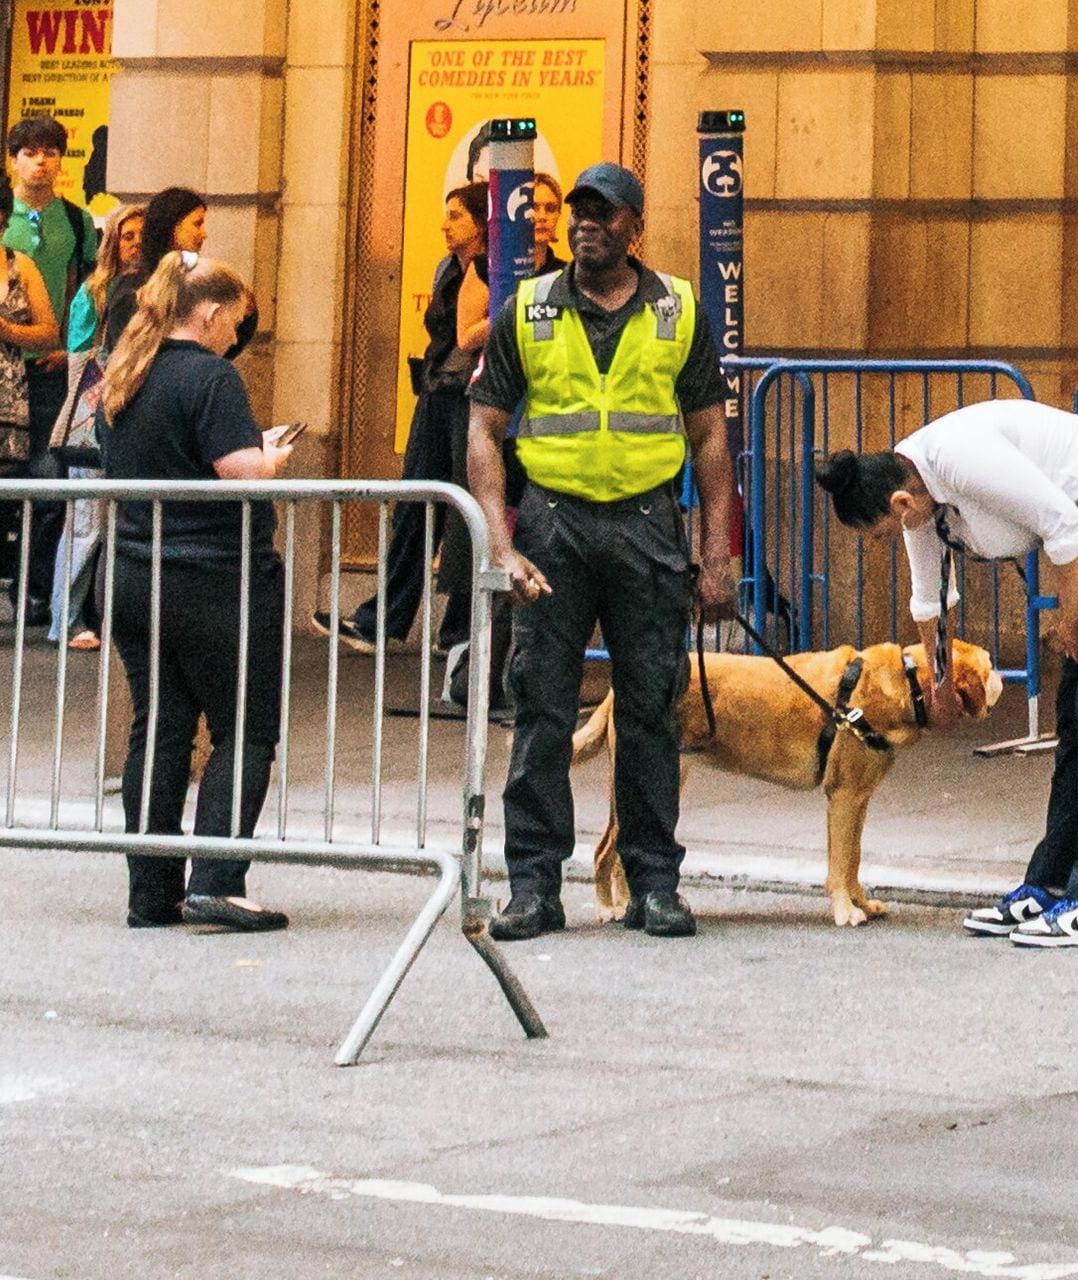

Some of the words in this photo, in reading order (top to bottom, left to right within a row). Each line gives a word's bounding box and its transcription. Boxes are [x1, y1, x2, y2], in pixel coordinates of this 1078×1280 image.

[26, 9, 112, 55] WIN
[472, 50, 495, 68] OF
[502, 50, 536, 67] THE
[542, 50, 588, 67] BEST
[418, 70, 507, 87] COMEDIES
[512, 70, 533, 87] IN
